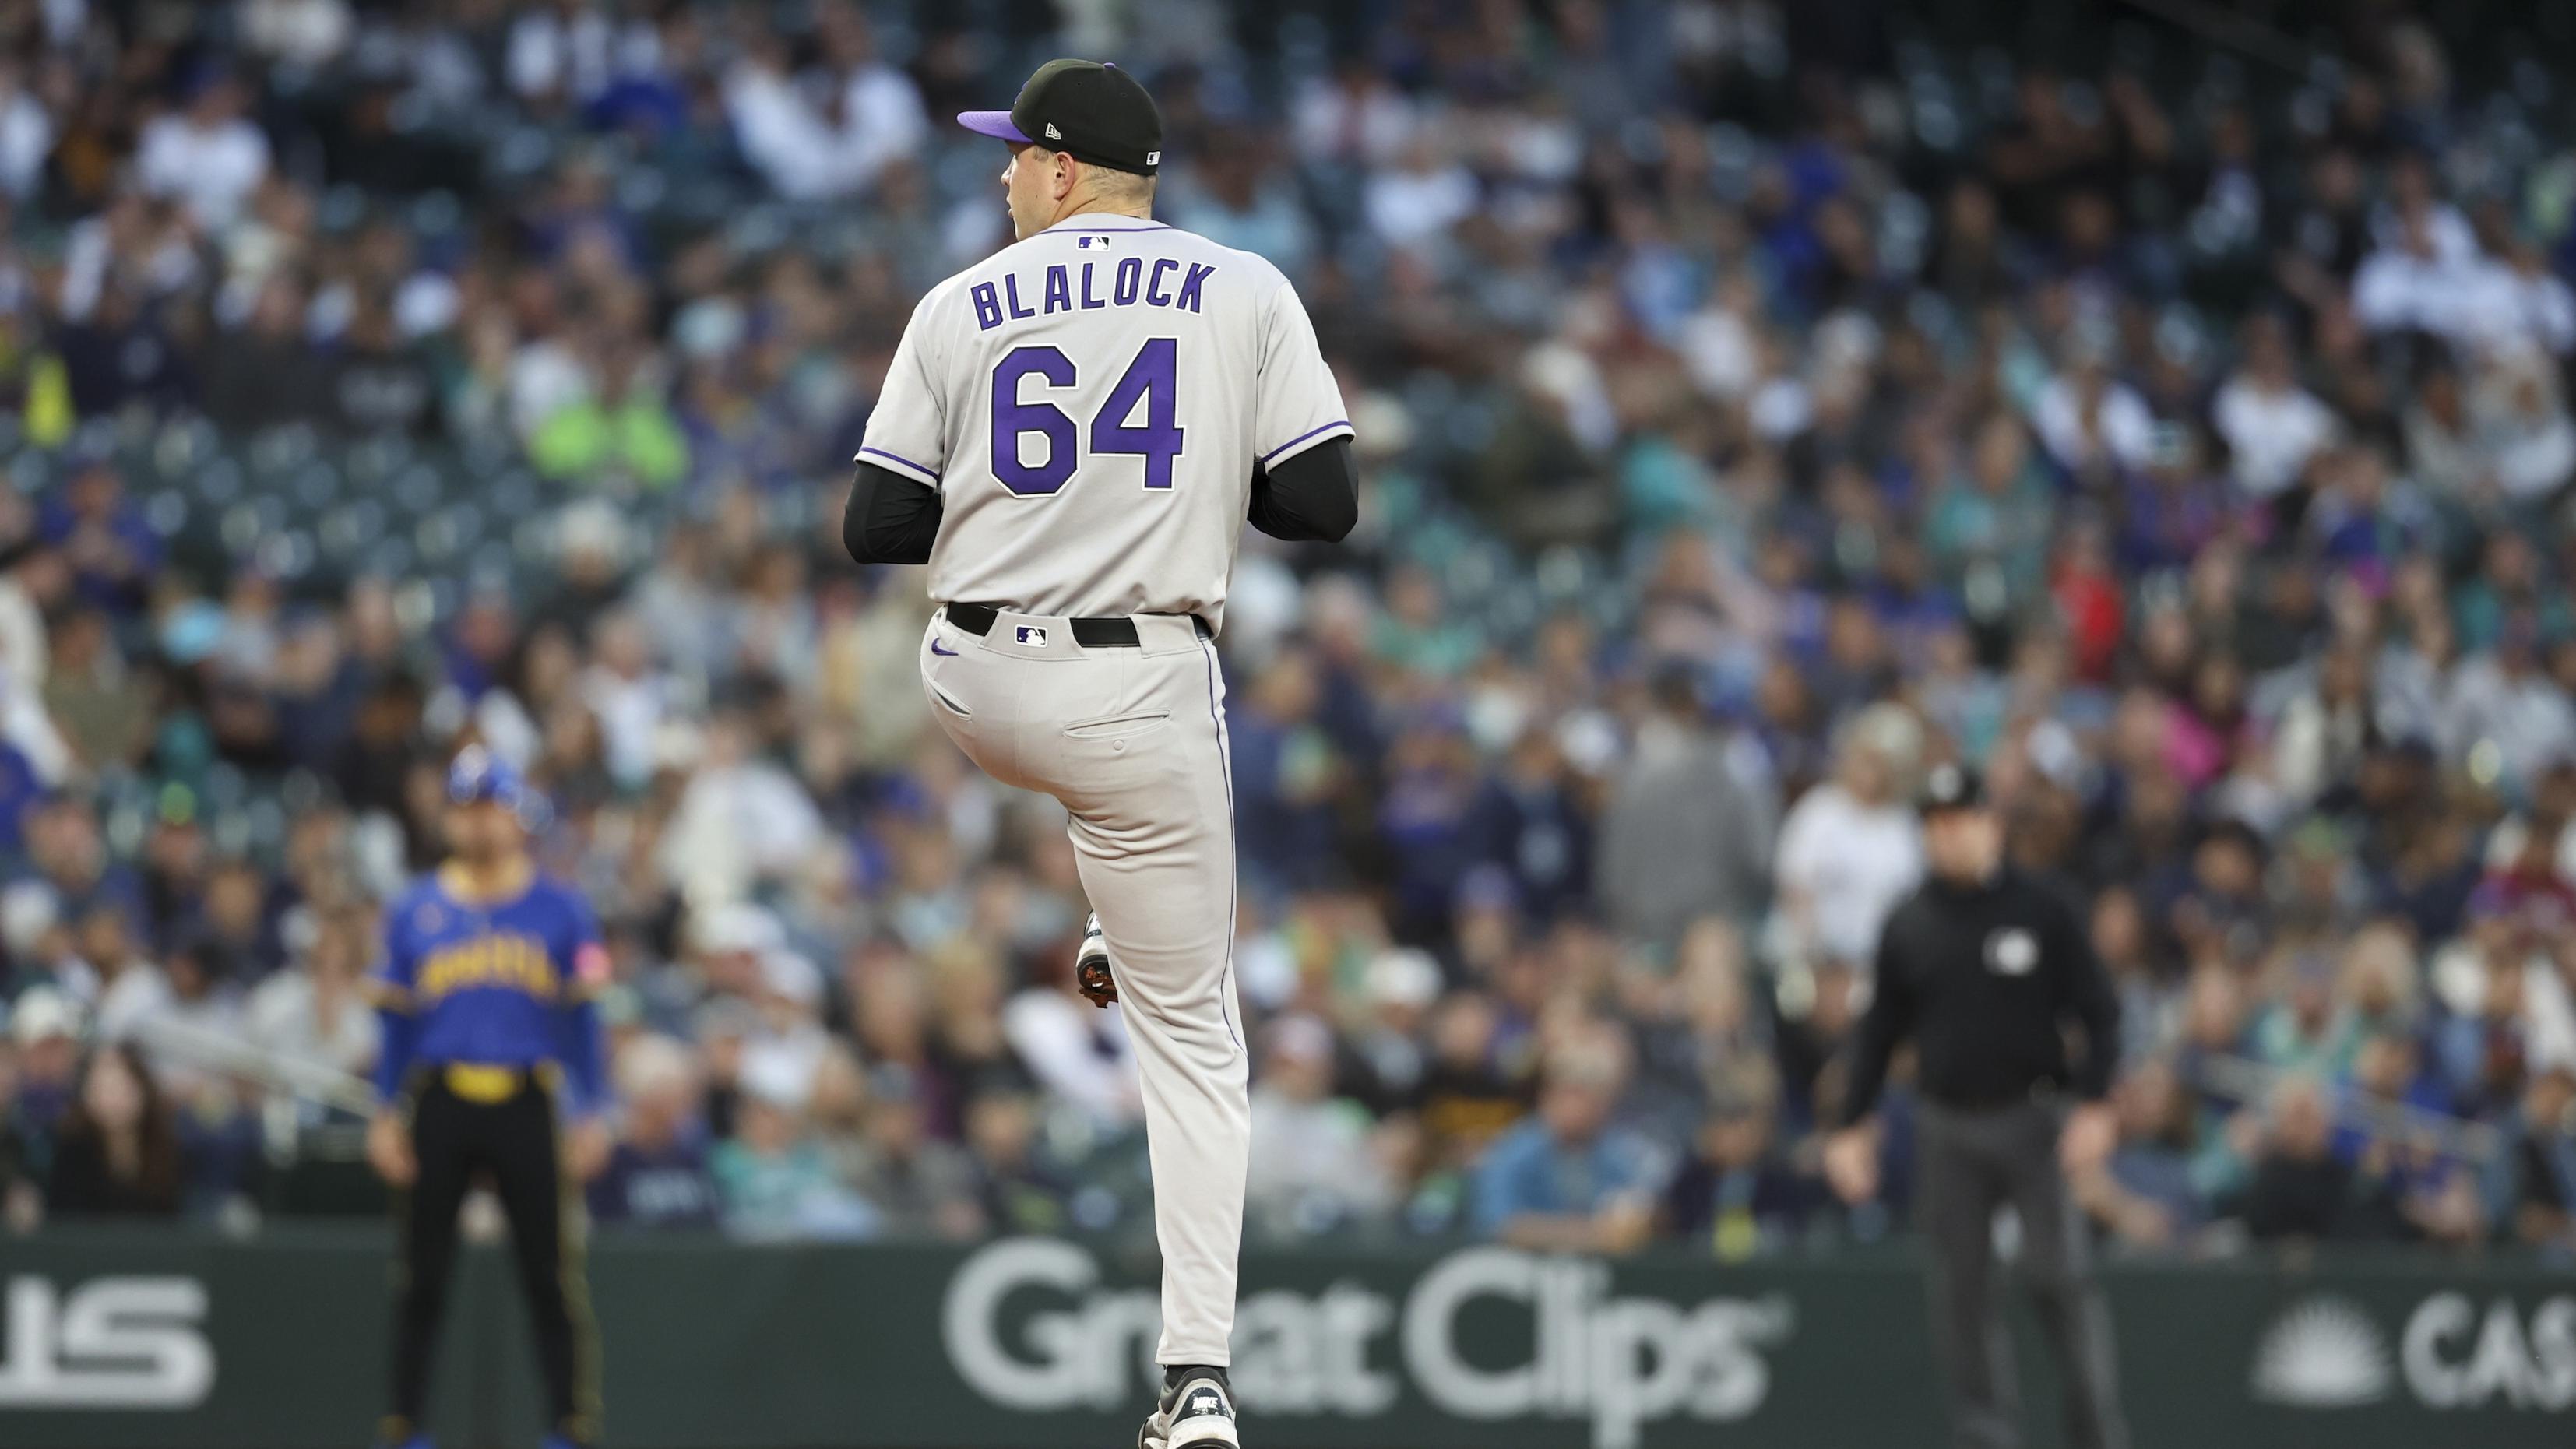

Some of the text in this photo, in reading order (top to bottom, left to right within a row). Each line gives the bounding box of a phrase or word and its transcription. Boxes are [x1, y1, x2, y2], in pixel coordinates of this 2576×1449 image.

[970, 257, 1218, 332] BLALOCK
[990, 336, 1185, 498] 64
[941, 1240, 1768, 1449] Grat Clips
[1192, 1396, 1218, 1410] NIKE
